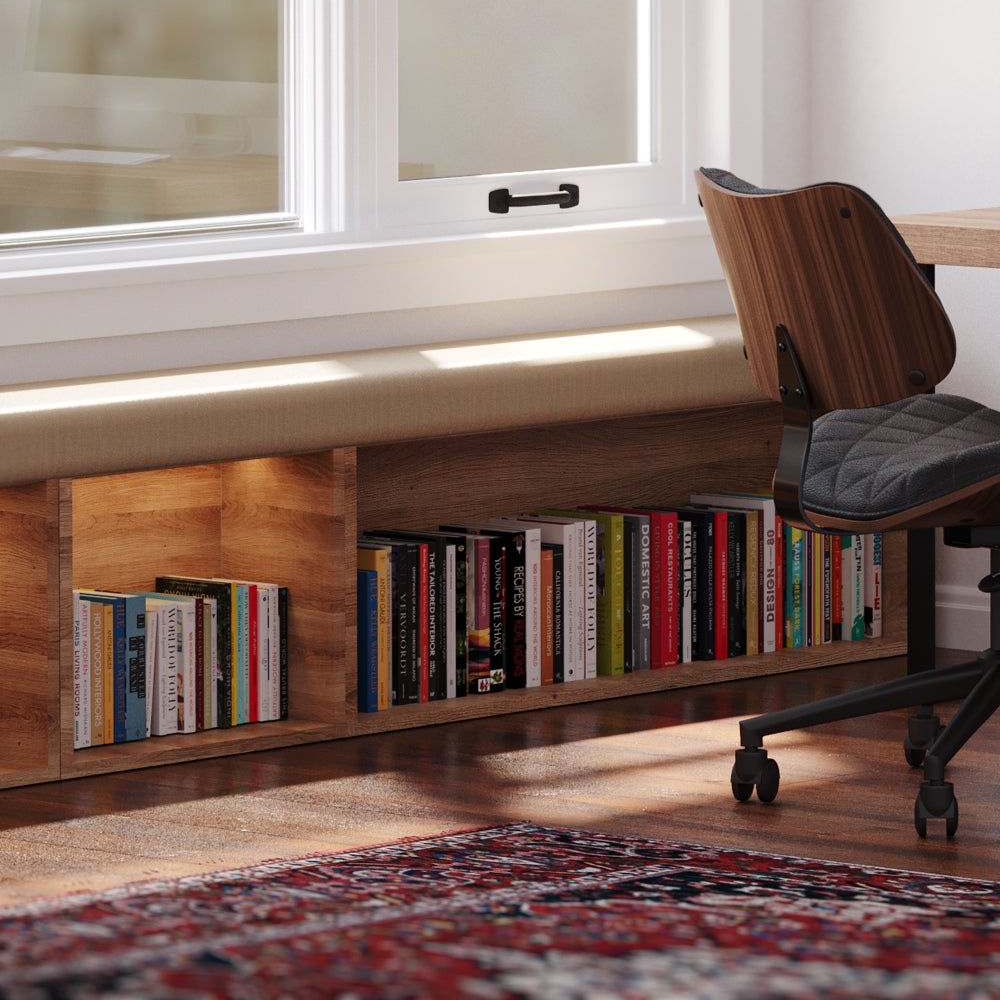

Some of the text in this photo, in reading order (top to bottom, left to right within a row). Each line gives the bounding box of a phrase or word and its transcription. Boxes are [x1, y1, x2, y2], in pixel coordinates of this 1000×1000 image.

[587, 526, 595, 581] WORLD
[641, 524, 650, 629] DOMESTIC ART
[493, 601, 502, 620] THE
[513, 566, 524, 677] RECIPES BY REAL MOMS
[587, 584, 595, 605] OF
[766, 568, 774, 623] DESIGN
[167, 608, 176, 712] WORLD OF FOLLY
[493, 622, 503, 656] SHACK
